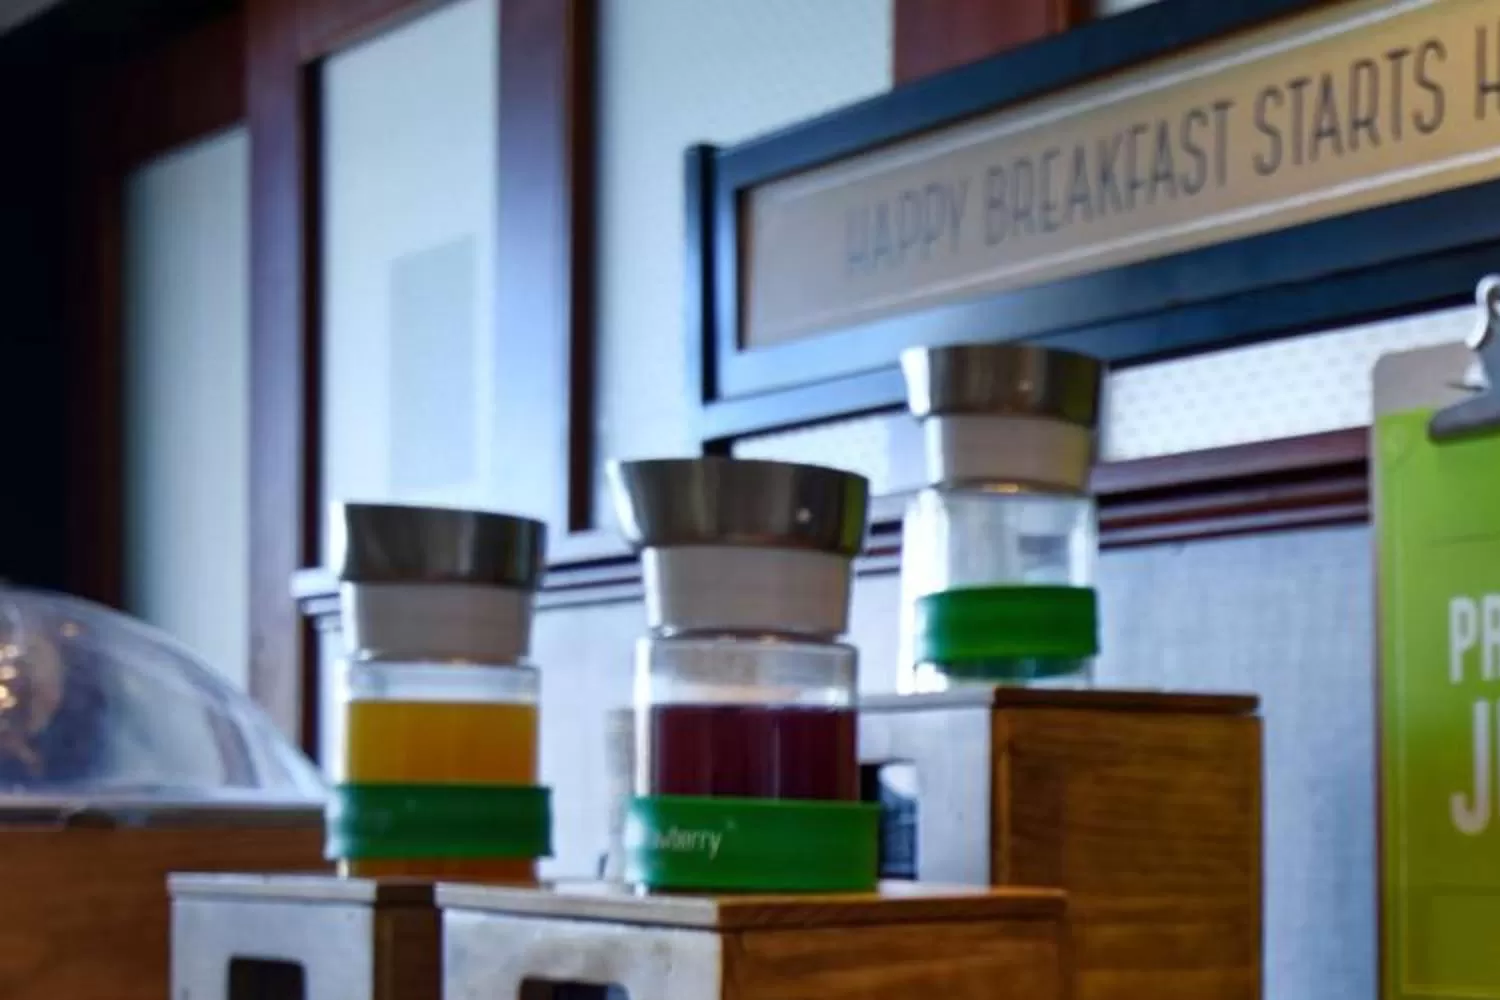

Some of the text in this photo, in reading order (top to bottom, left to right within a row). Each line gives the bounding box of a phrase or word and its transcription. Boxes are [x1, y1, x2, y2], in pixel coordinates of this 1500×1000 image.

[845, 174, 972, 278] HAPPY
[984, 100, 1236, 246] BREAKFAST
[1252, 37, 1448, 178] STARTS
